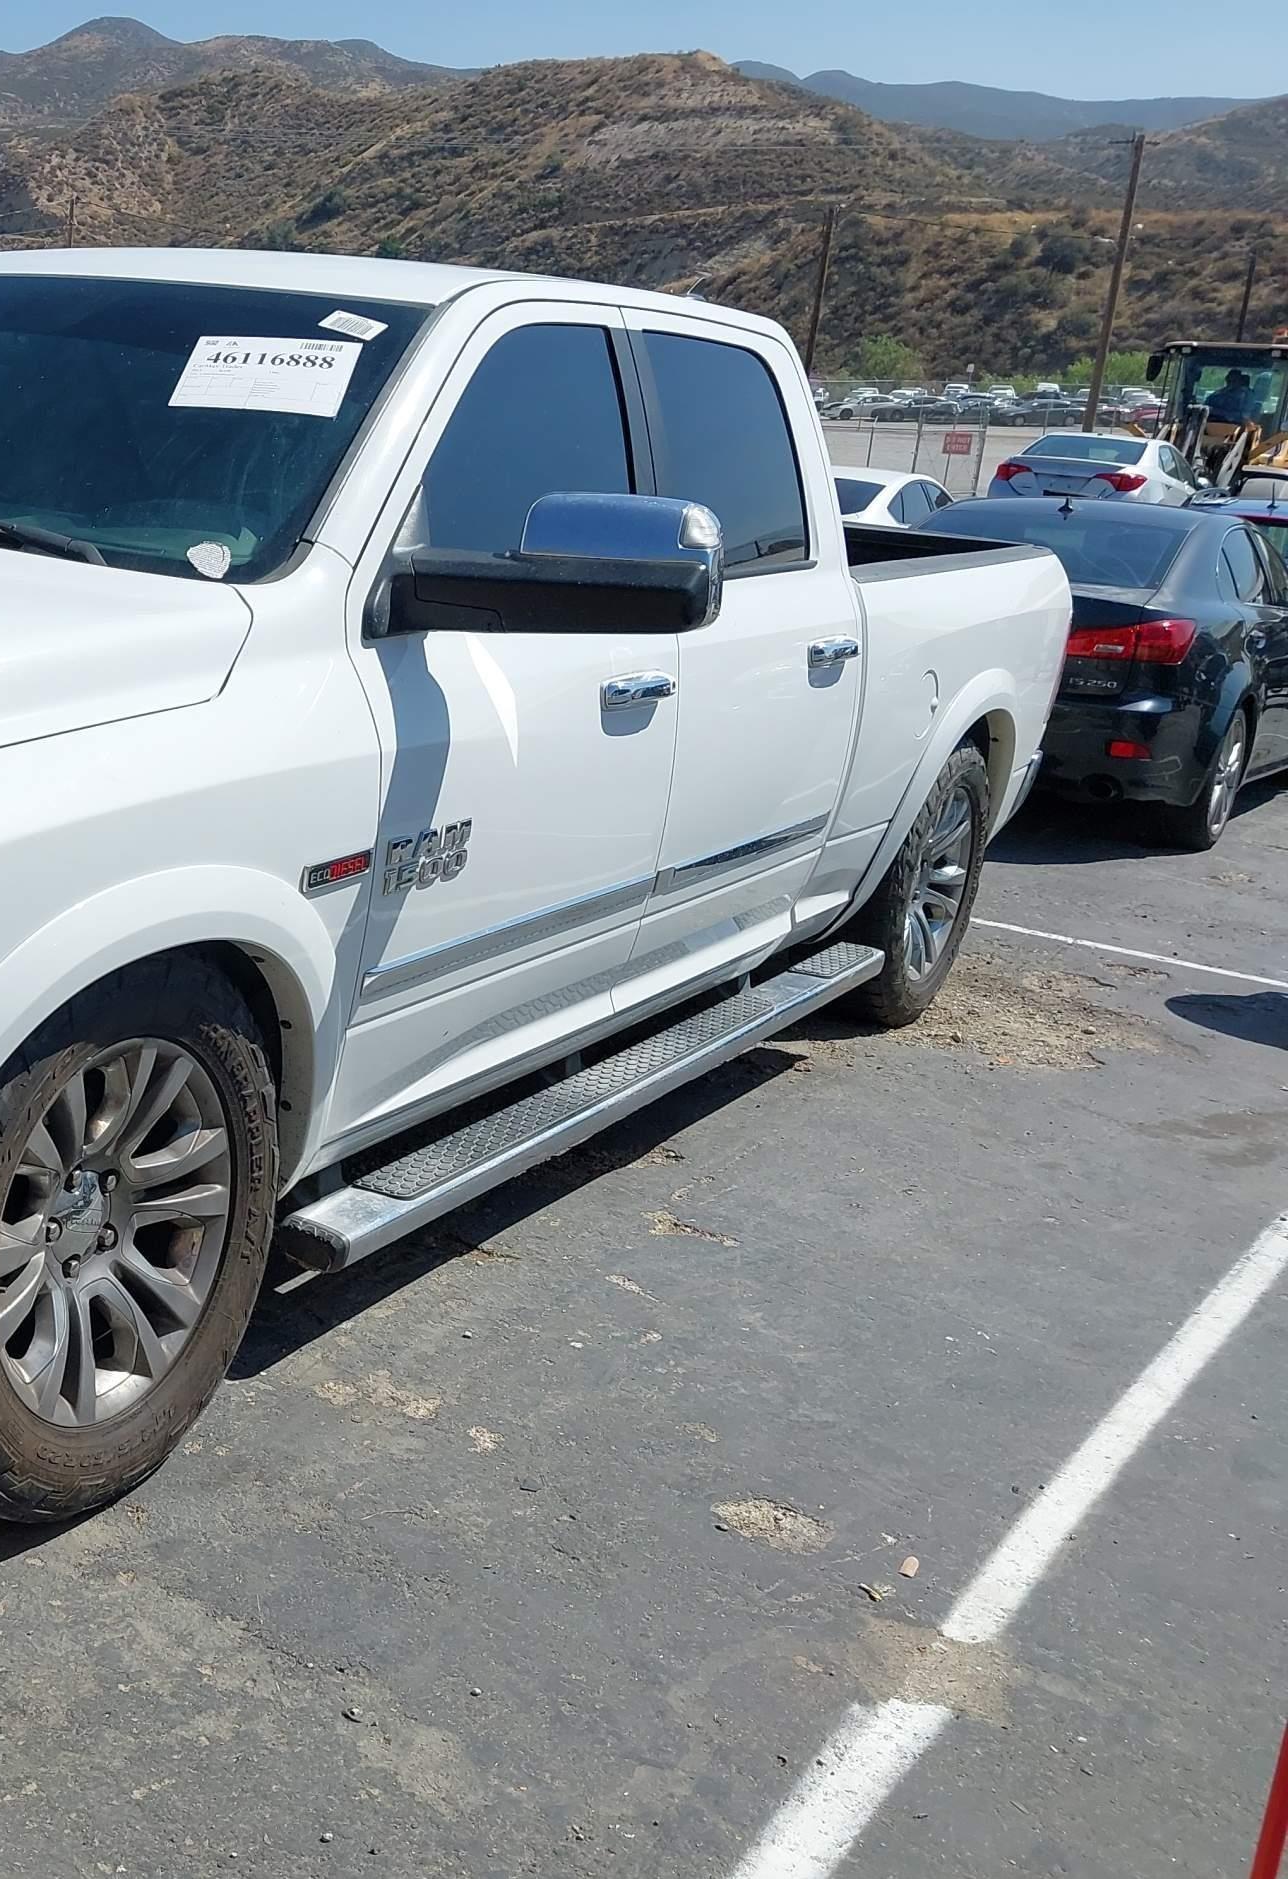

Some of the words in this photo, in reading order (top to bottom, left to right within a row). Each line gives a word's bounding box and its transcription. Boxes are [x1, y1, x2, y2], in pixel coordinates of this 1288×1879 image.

[206, 351, 336, 370] 46116888
[1085, 679, 1118, 689] 250
[386, 817, 473, 866] RAM
[383, 848, 469, 897] 1500
